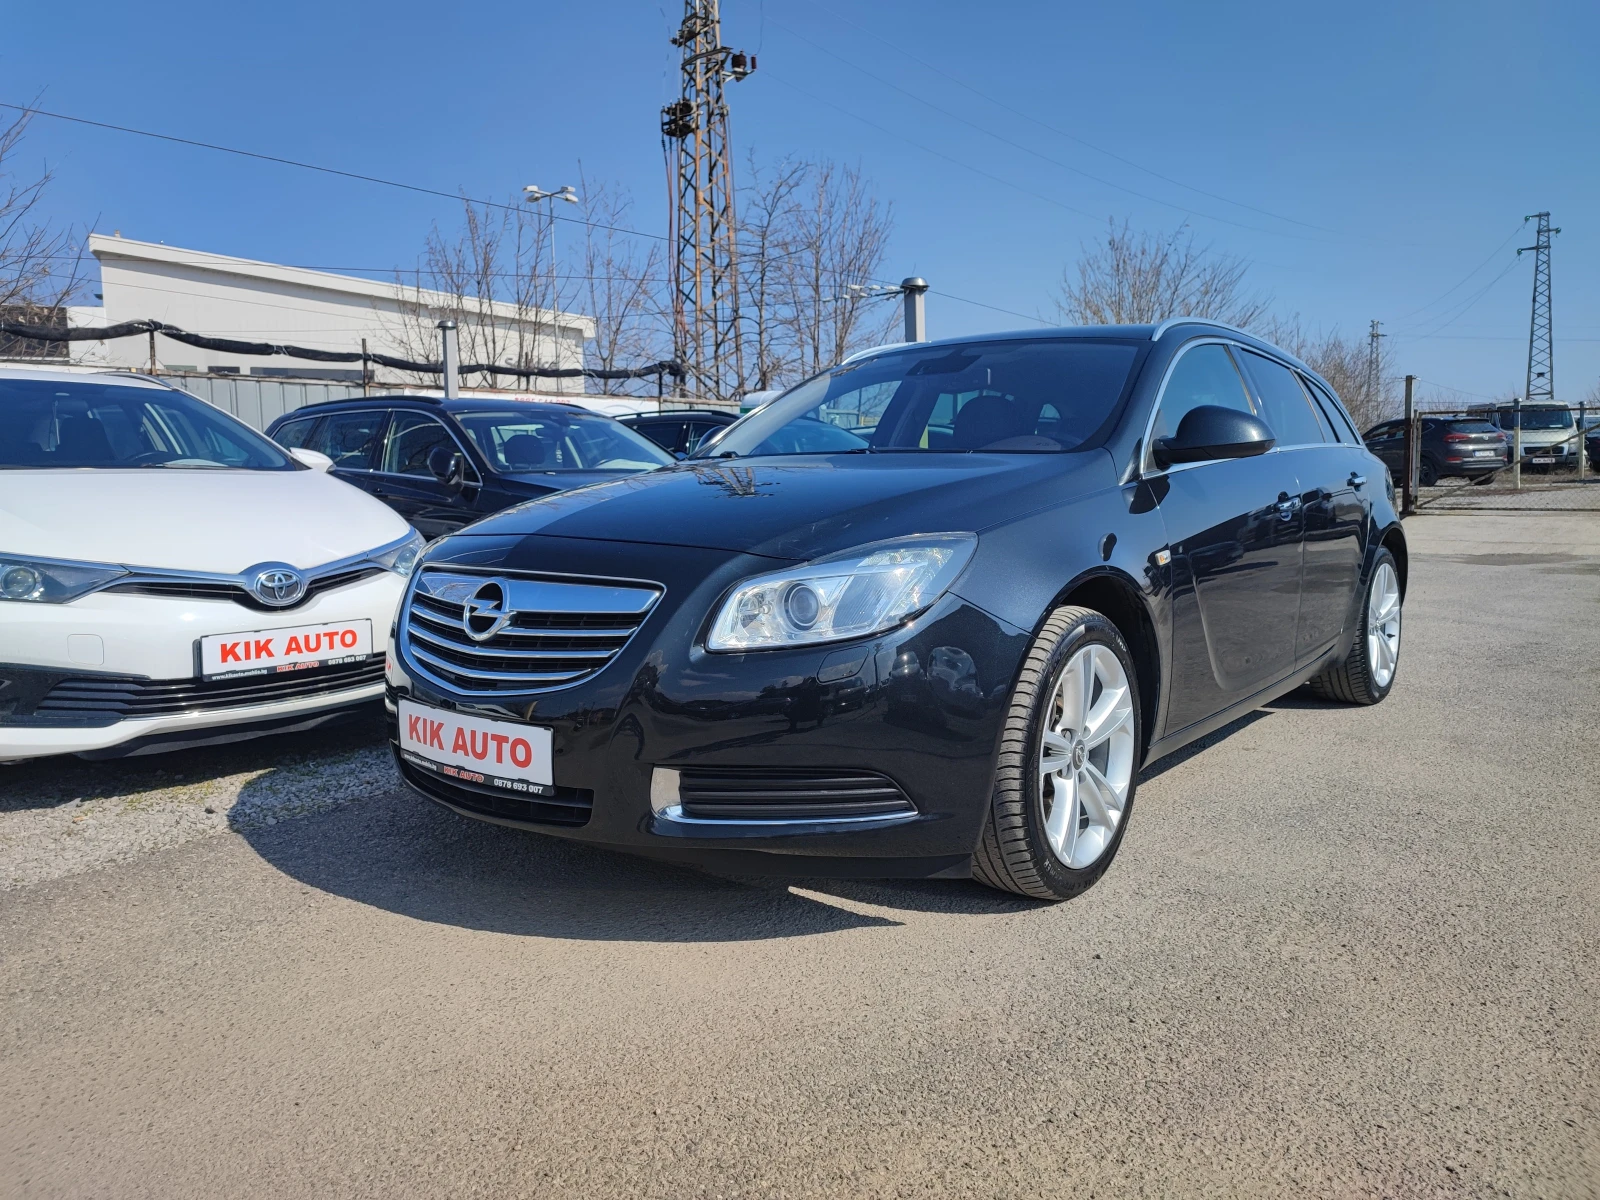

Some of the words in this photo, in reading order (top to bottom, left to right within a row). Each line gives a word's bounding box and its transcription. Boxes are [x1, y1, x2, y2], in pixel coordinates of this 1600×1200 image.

[220, 637, 275, 664] KIK
[284, 629, 358, 656] AUTO
[276, 663, 295, 673] KIK
[295, 661, 320, 671] AUTO
[327, 658, 343, 666] 0878
[355, 654, 367, 662] 007
[408, 713, 445, 751] KIK
[451, 726, 533, 769] AUTO
[443, 765, 459, 778] KIK
[458, 770, 485, 783] AUTO
[493, 777, 512, 790] 0878
[512, 780, 528, 792] 693
[528, 782, 544, 795] 007
